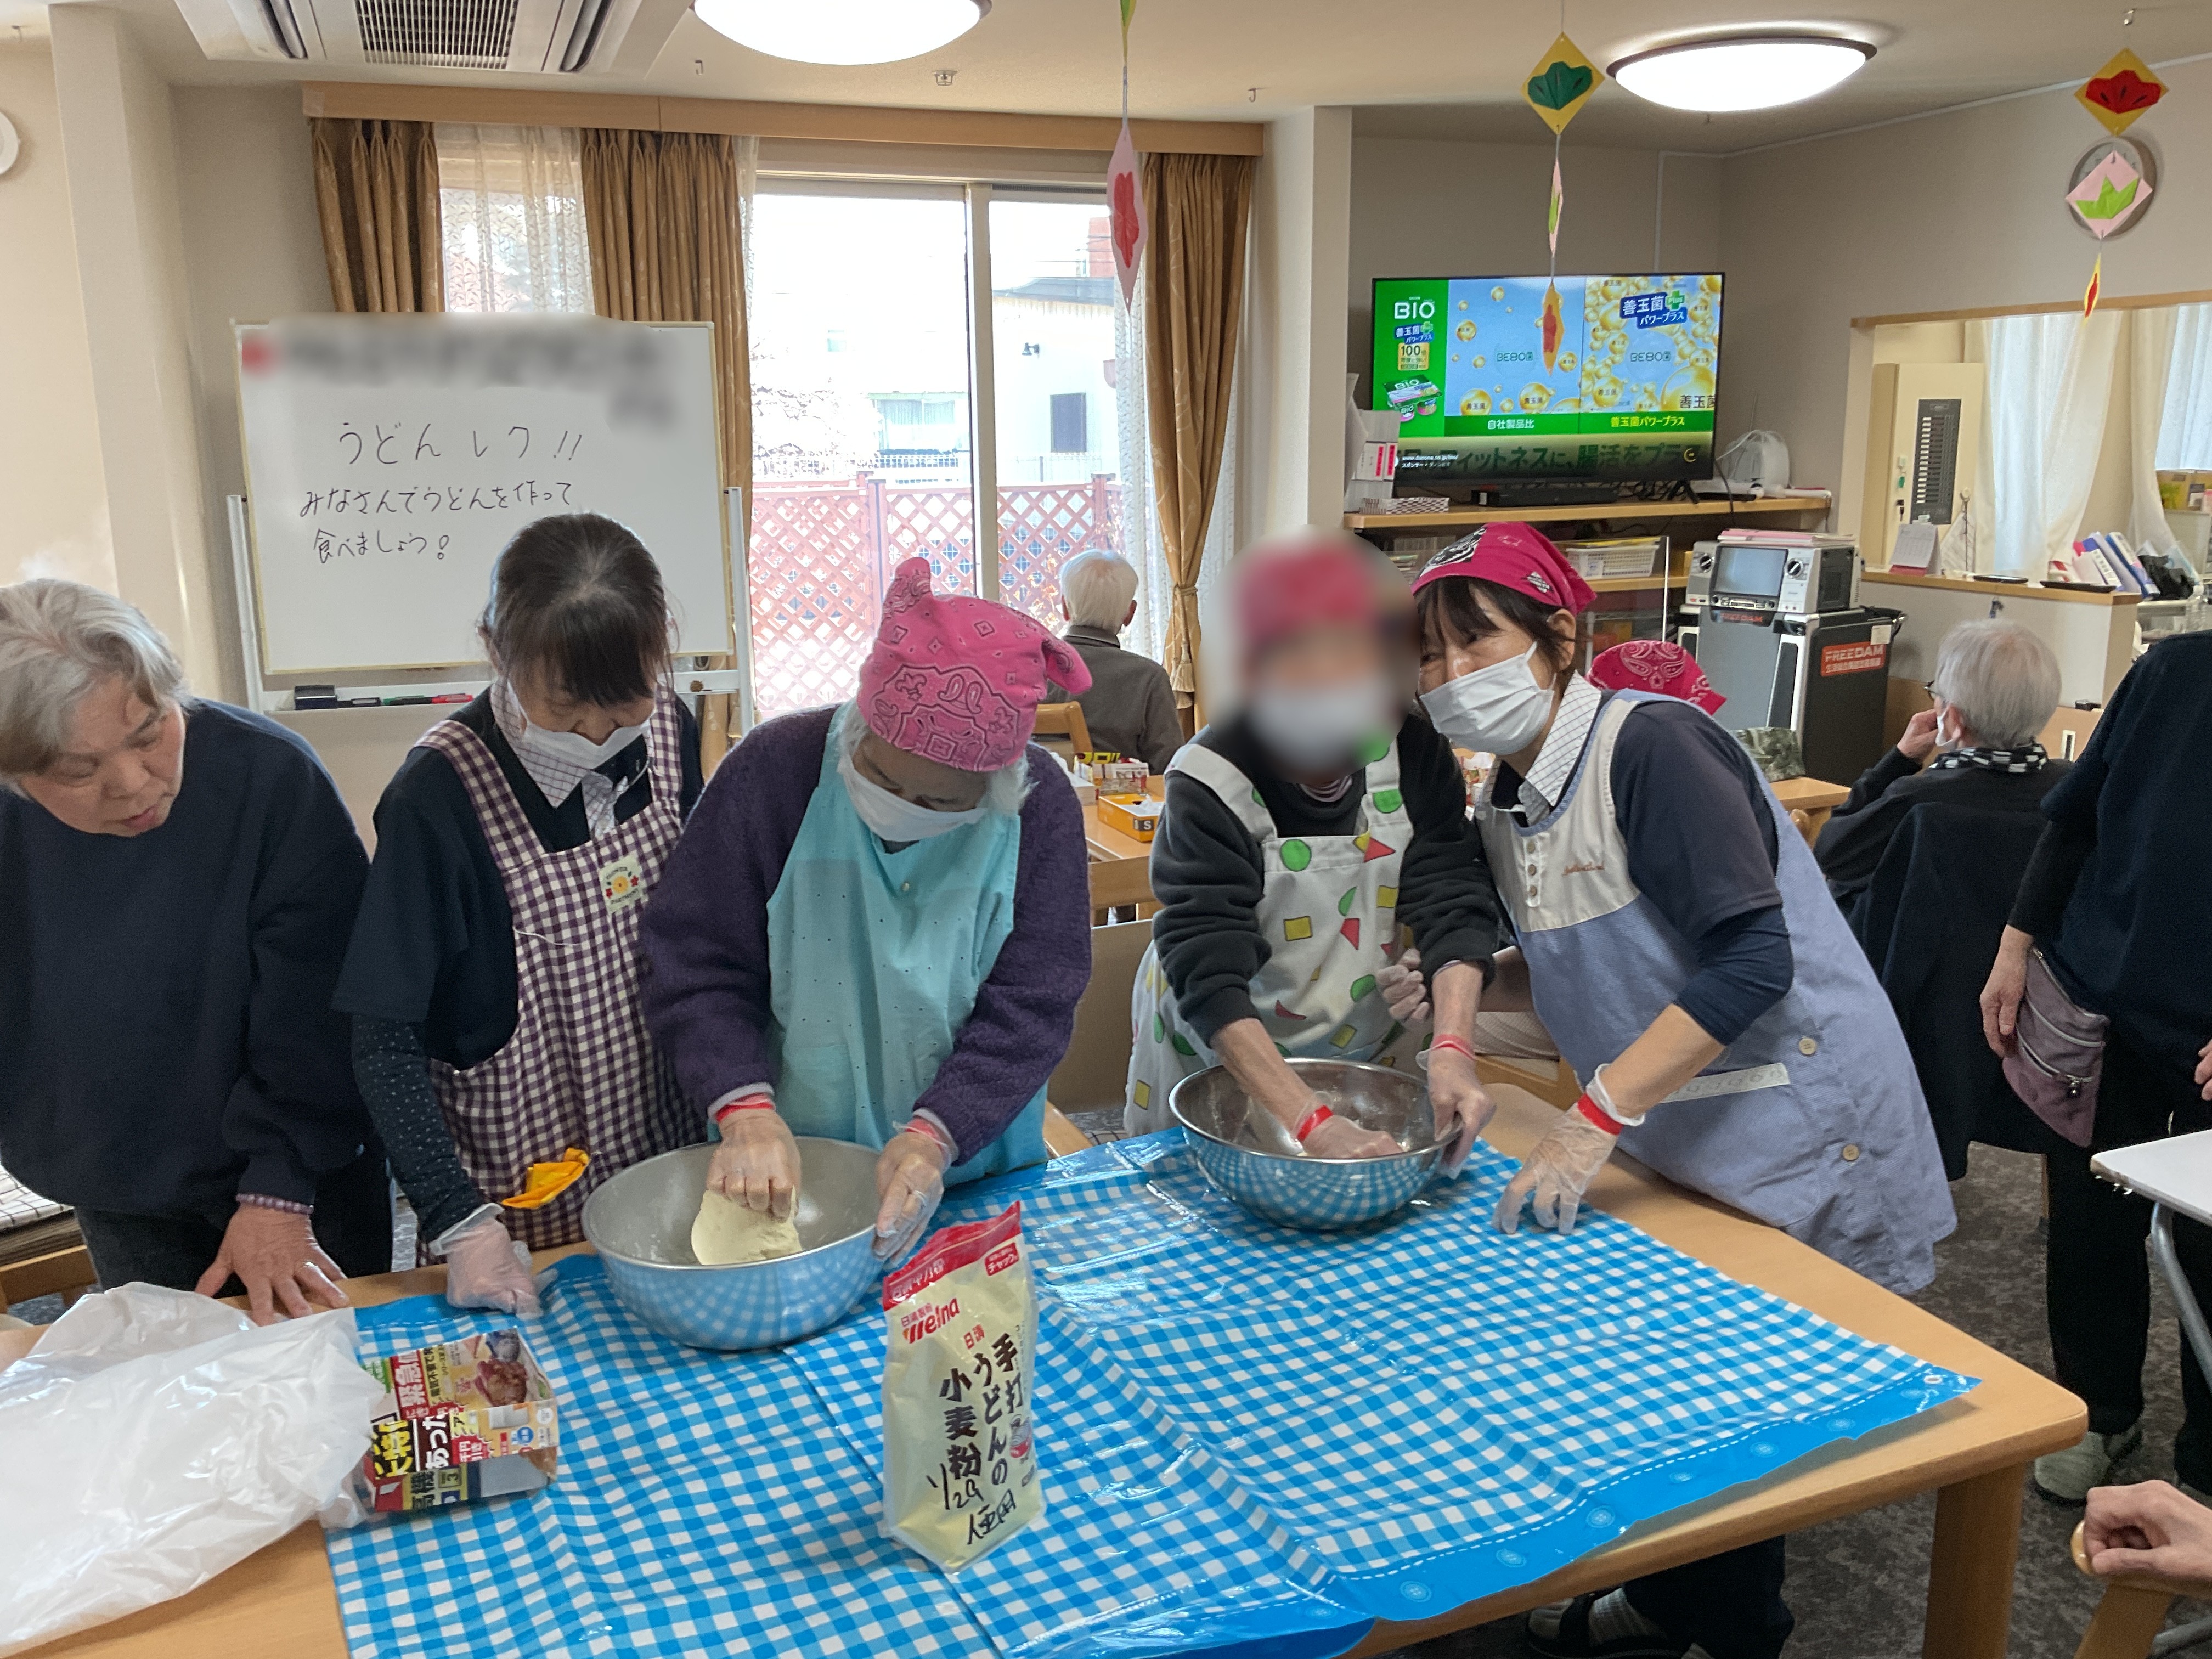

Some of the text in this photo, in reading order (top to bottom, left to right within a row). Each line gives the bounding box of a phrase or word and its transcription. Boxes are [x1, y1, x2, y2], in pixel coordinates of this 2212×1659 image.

[1395, 301, 1435, 319] BIO
[1622, 296, 1664, 315] 善玉菌
[1640, 311, 1685, 325] パワープラス
[1394, 379, 1419, 390] BIO
[1487, 419, 1534, 430] 自社製品比
[1611, 416, 1685, 427] 善玉菌パワープラス
[339, 422, 441, 465] うどん
[300, 481, 573, 518] みなさんでうどんを作って
[1825, 645, 1884, 662] FREEDAM
[963, 1324, 985, 1349] 日清
[991, 1332, 1023, 1414] 手打
[939, 1368, 982, 1480] 小麦粉
[973, 1352, 1008, 1485] うどんの
[967, 1488, 1017, 1545] 使用
